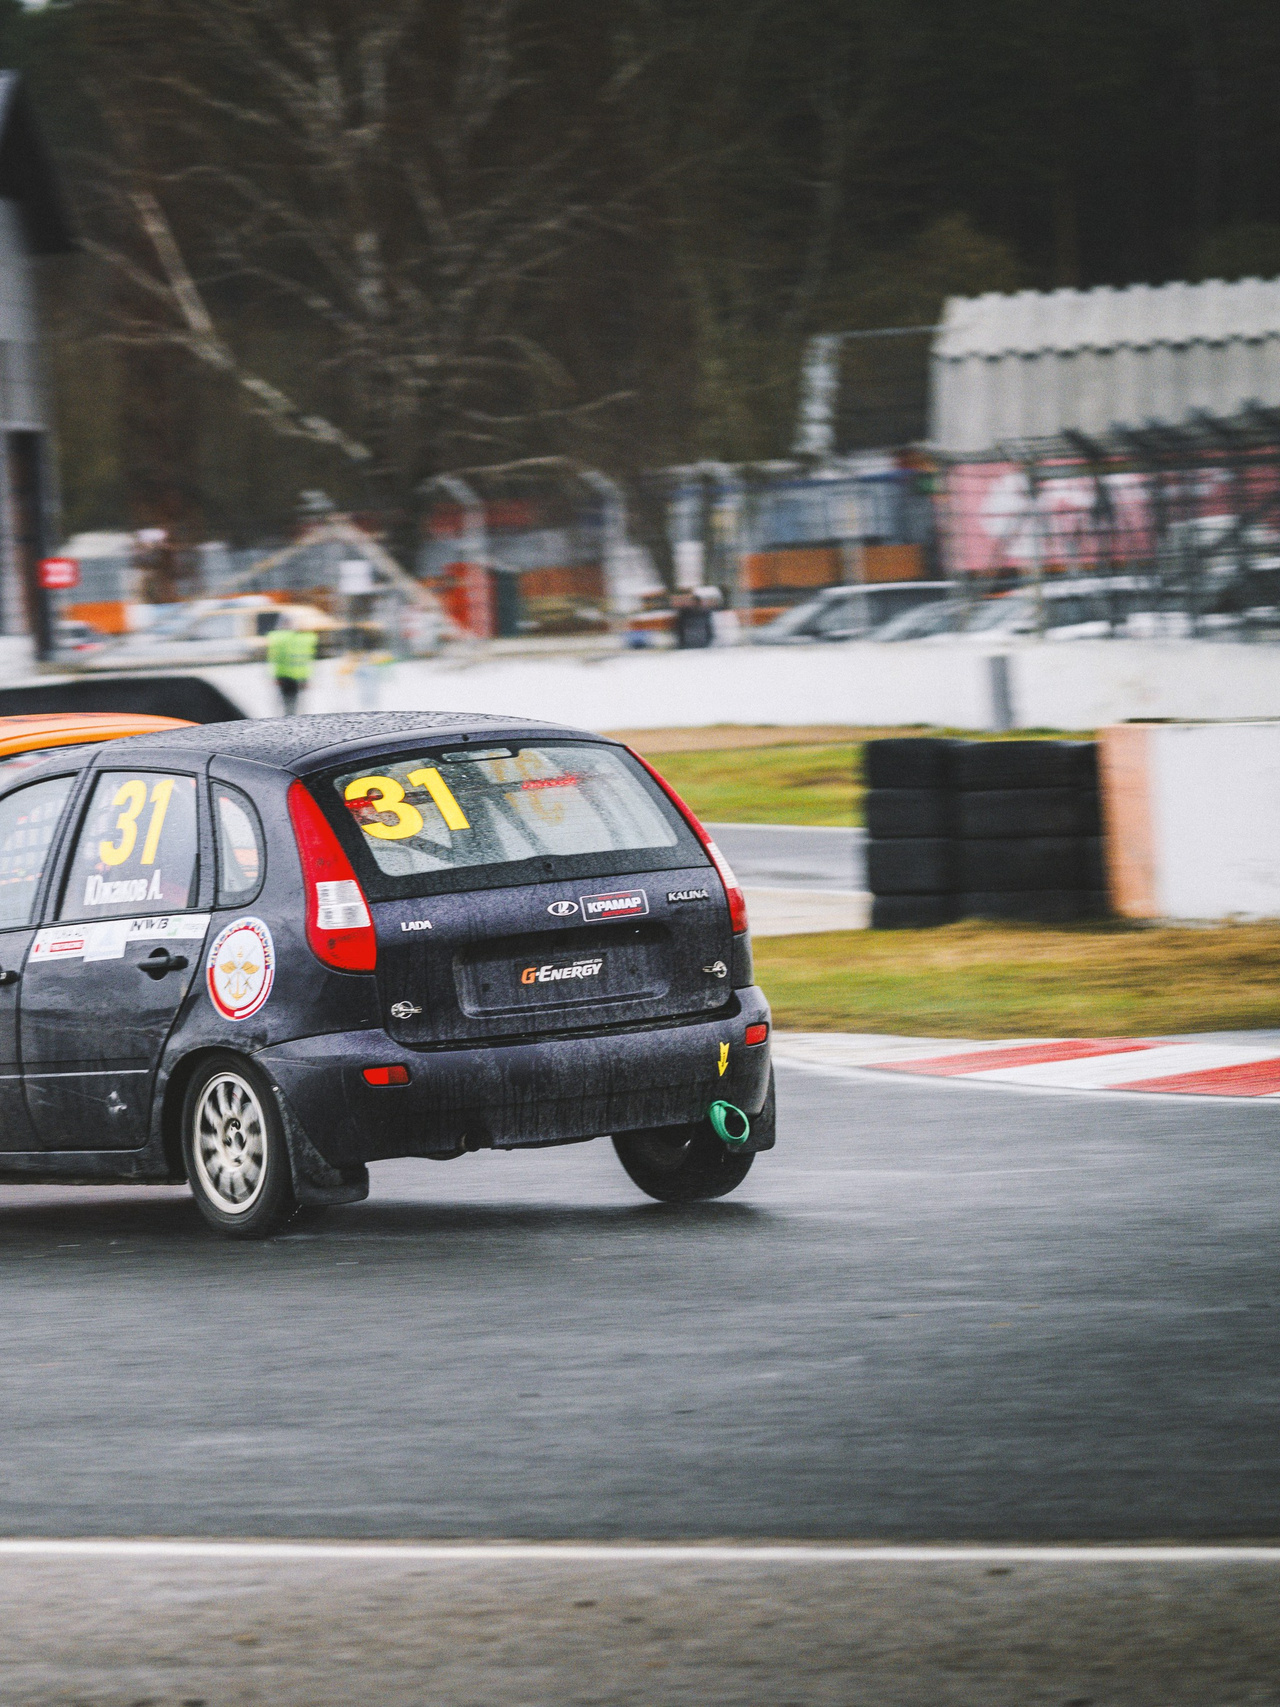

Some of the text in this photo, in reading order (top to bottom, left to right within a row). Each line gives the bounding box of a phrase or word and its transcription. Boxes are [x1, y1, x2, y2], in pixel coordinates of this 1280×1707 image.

[344, 766, 471, 840] 31
[100, 779, 174, 866] 31
[668, 889, 709, 902] KALINA
[587, 897, 641, 913] КРАМАР
[401, 920, 433, 931] LADA
